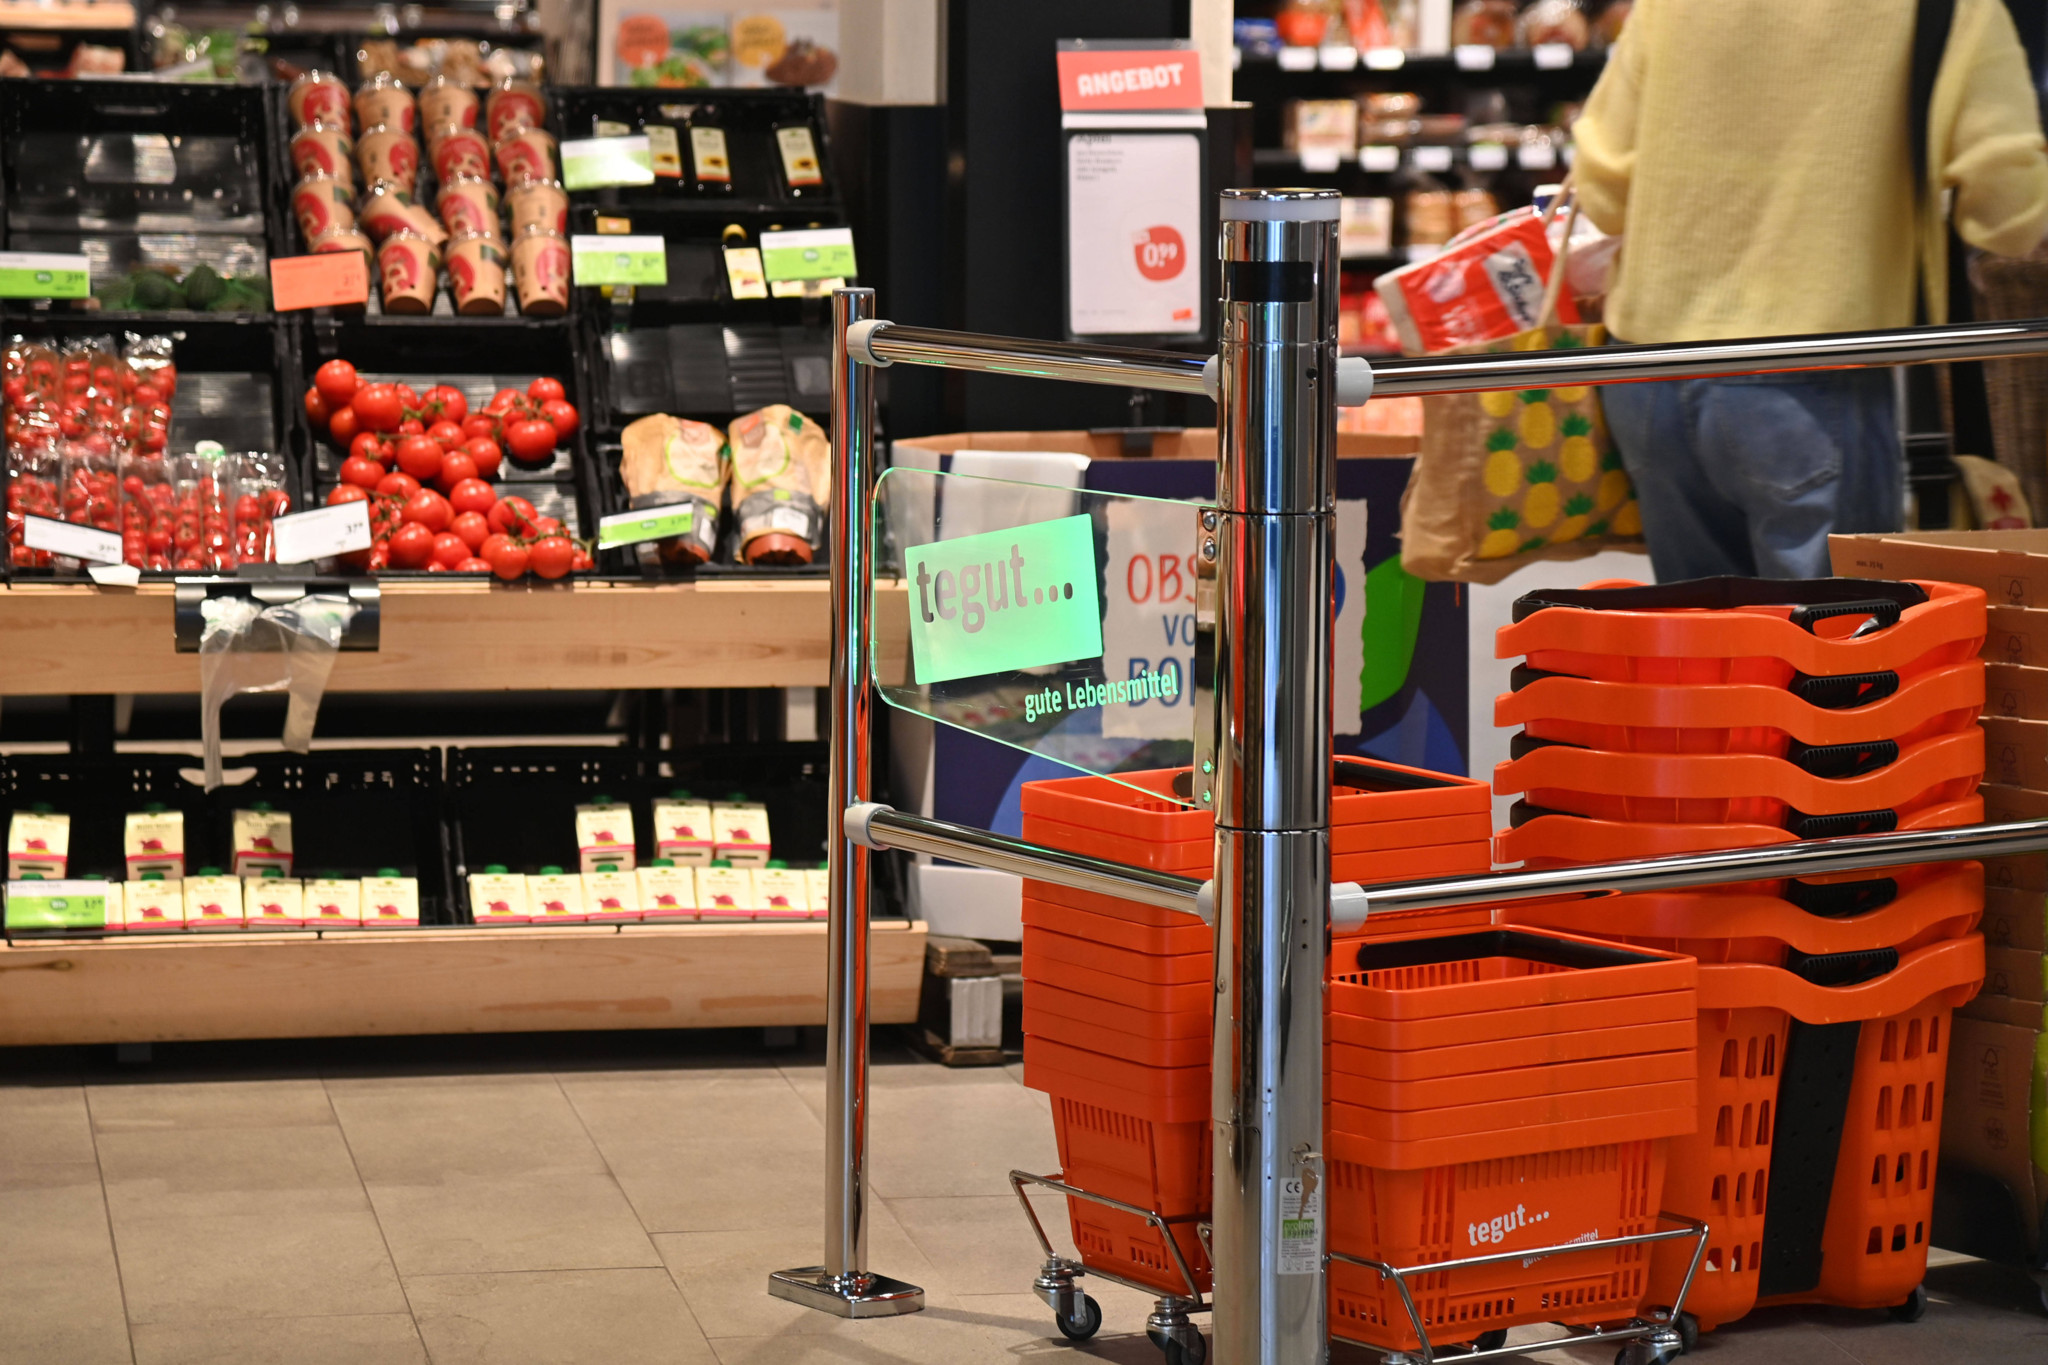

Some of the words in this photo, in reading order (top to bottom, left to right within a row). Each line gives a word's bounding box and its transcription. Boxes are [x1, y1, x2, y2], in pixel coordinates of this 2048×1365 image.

[1077, 63, 1184, 98] ANGEBOT
[916, 543, 1074, 634] tegut...
[1025, 687, 1063, 723] gute
[1066, 665, 1179, 710] Lebensmittel
[1129, 656, 1197, 708] BO
[1467, 1203, 1550, 1247] tegut...
